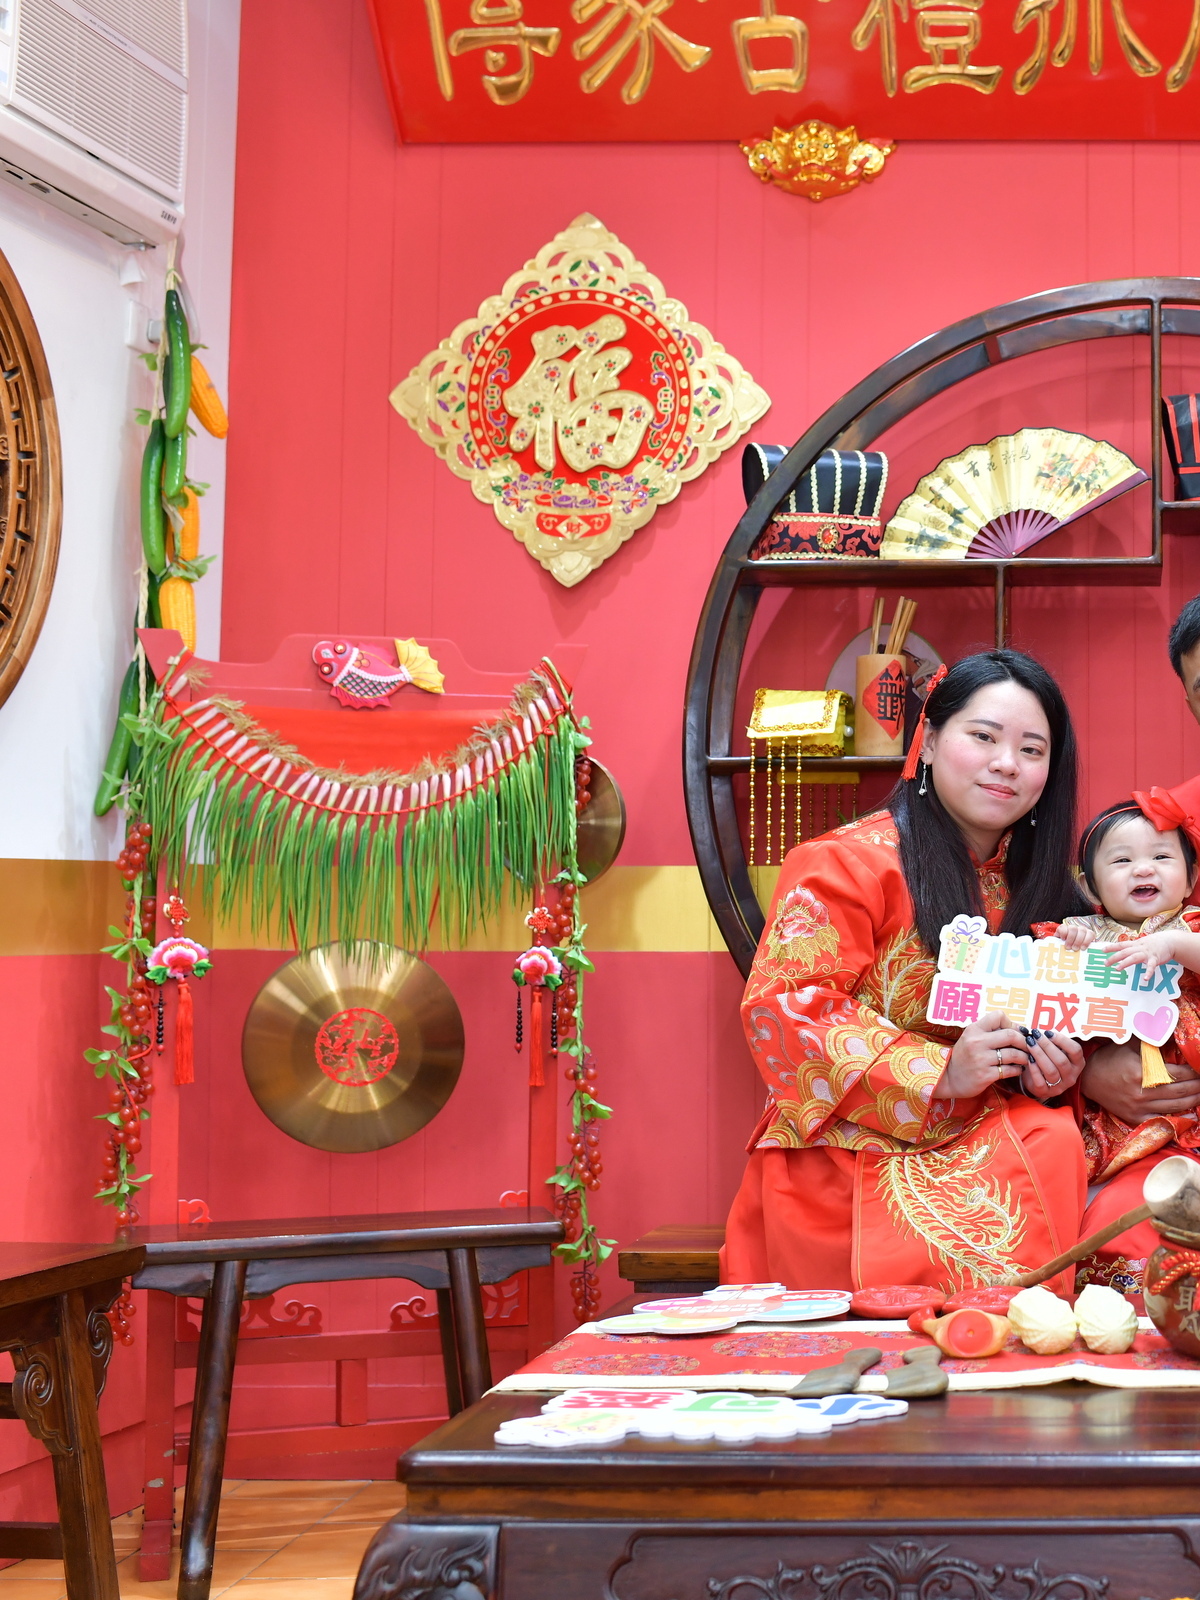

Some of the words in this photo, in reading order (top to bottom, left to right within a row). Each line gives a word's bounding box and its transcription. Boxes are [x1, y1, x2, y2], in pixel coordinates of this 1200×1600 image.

[502, 313, 655, 473] 福
[932, 979, 1129, 1038] 願望成真
